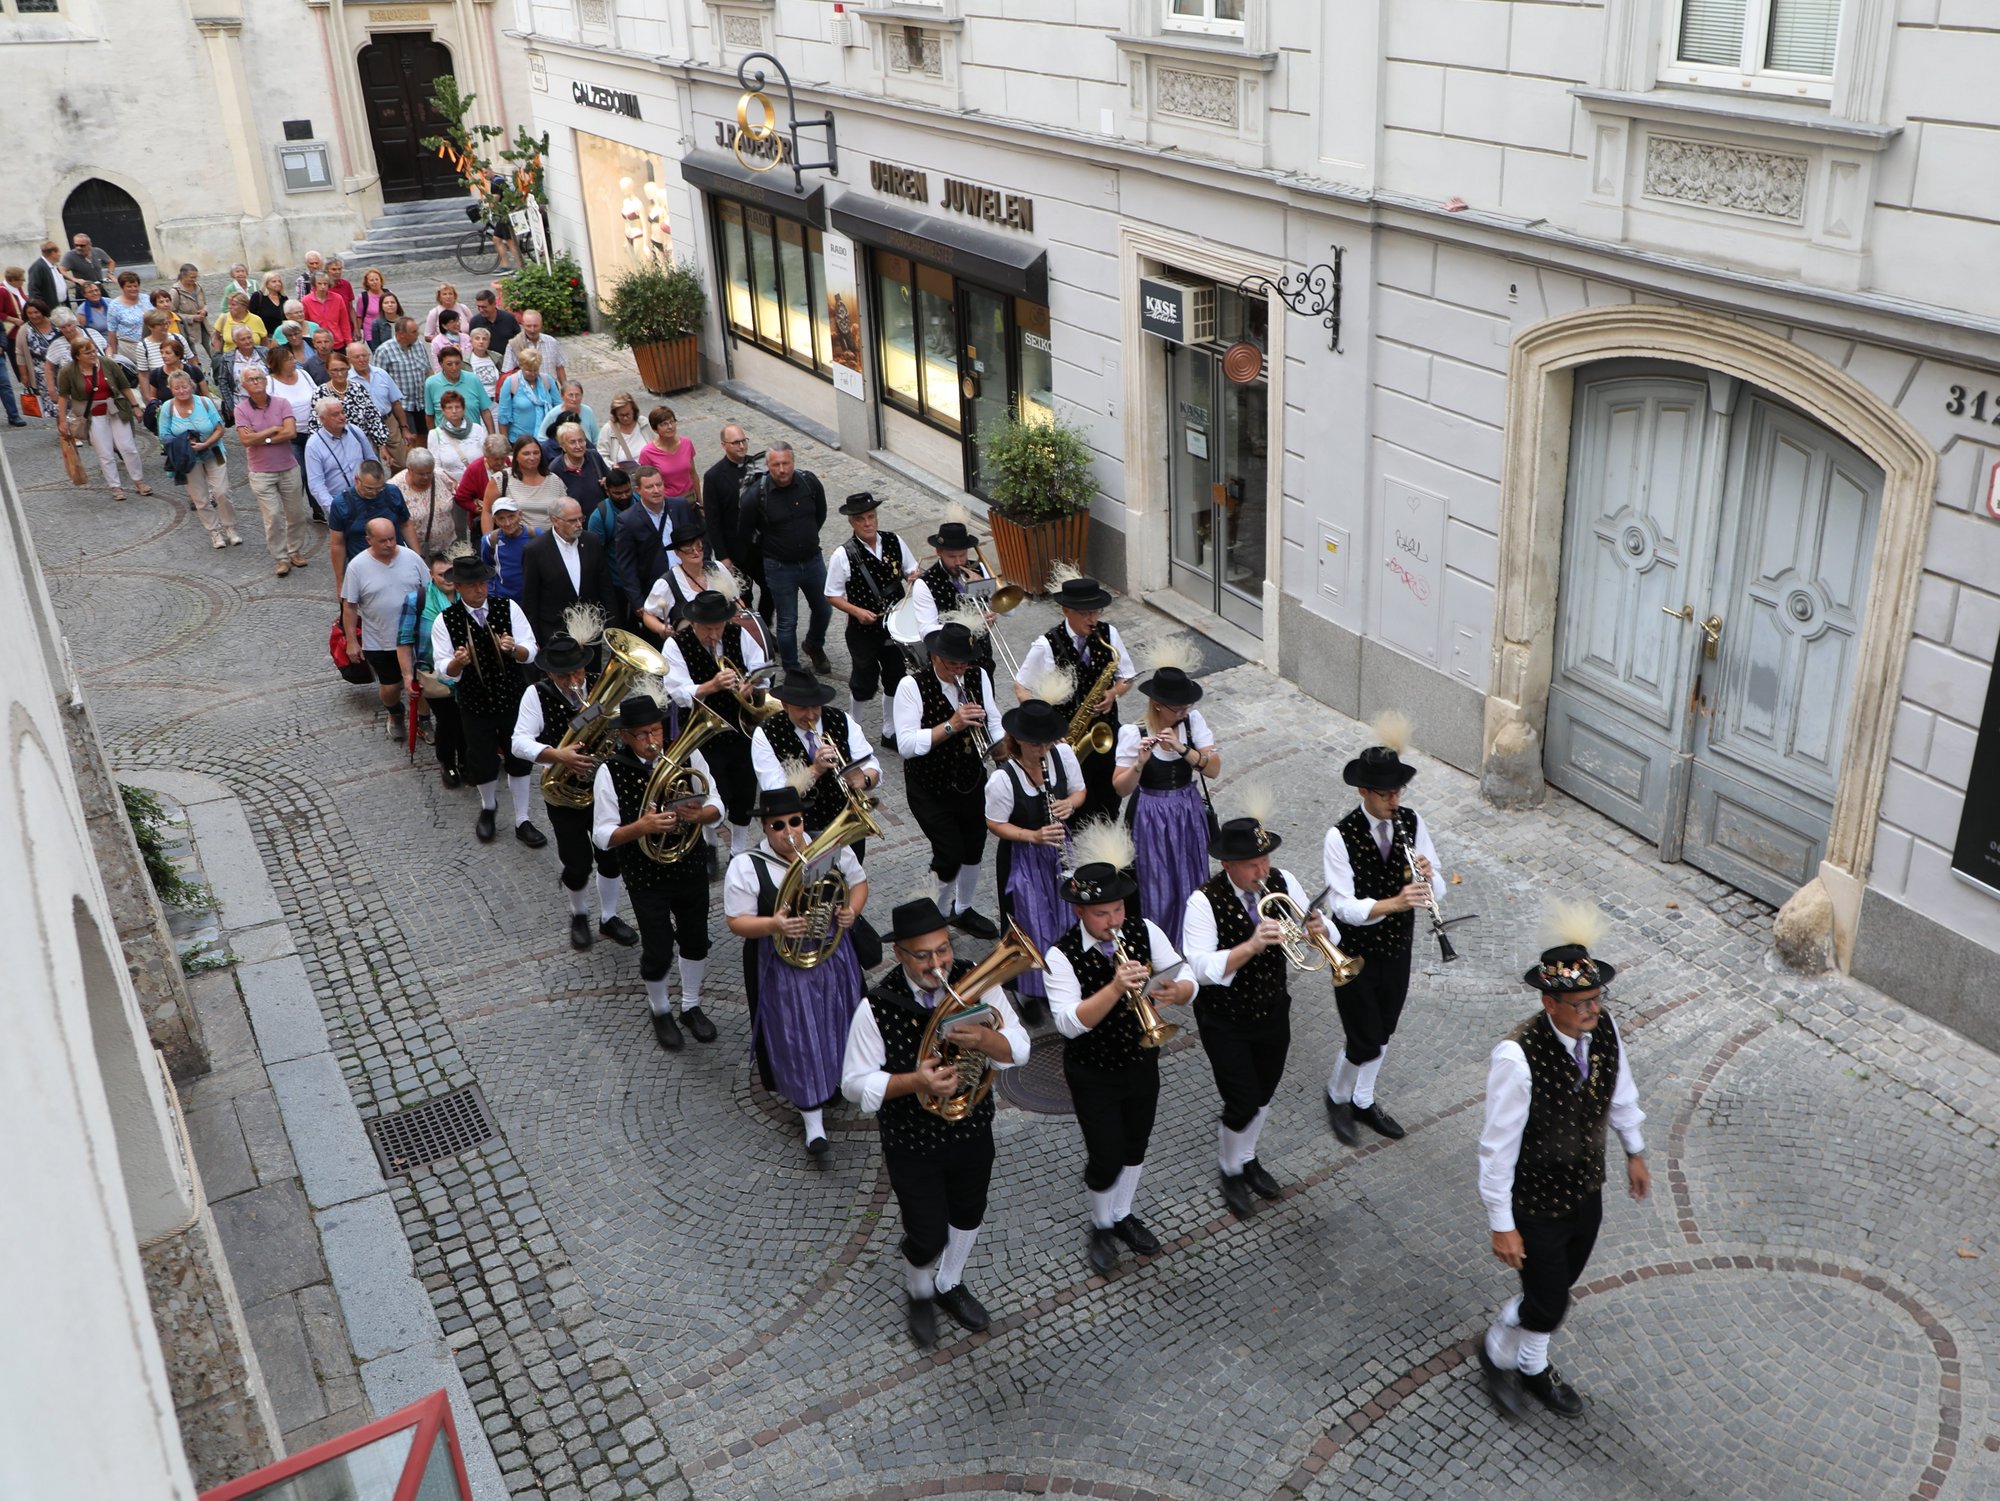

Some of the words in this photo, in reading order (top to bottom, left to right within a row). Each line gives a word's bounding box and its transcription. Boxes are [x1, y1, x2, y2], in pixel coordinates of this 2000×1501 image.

[572, 81, 643, 121] CALZEDONIA
[870, 160, 928, 203] UHREN
[940, 178, 1034, 233] JUWELEN
[830, 243, 847, 257] RADO
